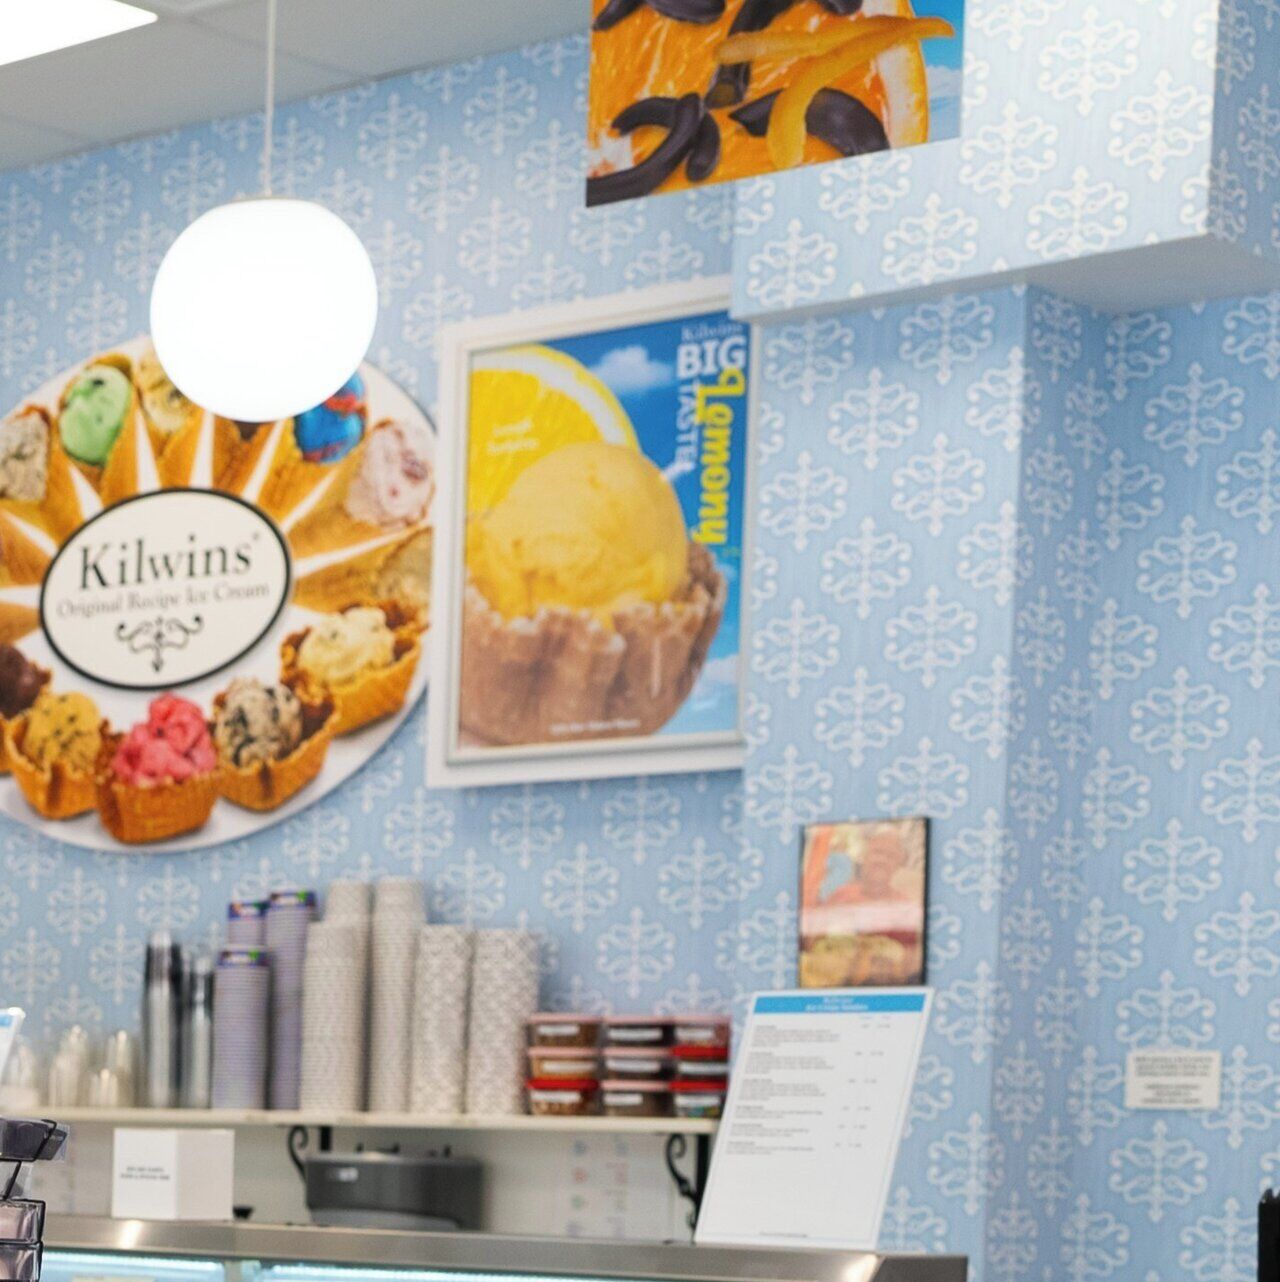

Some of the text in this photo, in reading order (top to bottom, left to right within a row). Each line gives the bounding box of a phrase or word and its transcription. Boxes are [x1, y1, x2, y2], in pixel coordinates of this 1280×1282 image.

[677, 336, 747, 380] BIG
[79, 533, 252, 591] Kilwins
[56, 581, 270, 618] Original Recipe Ice Cream
